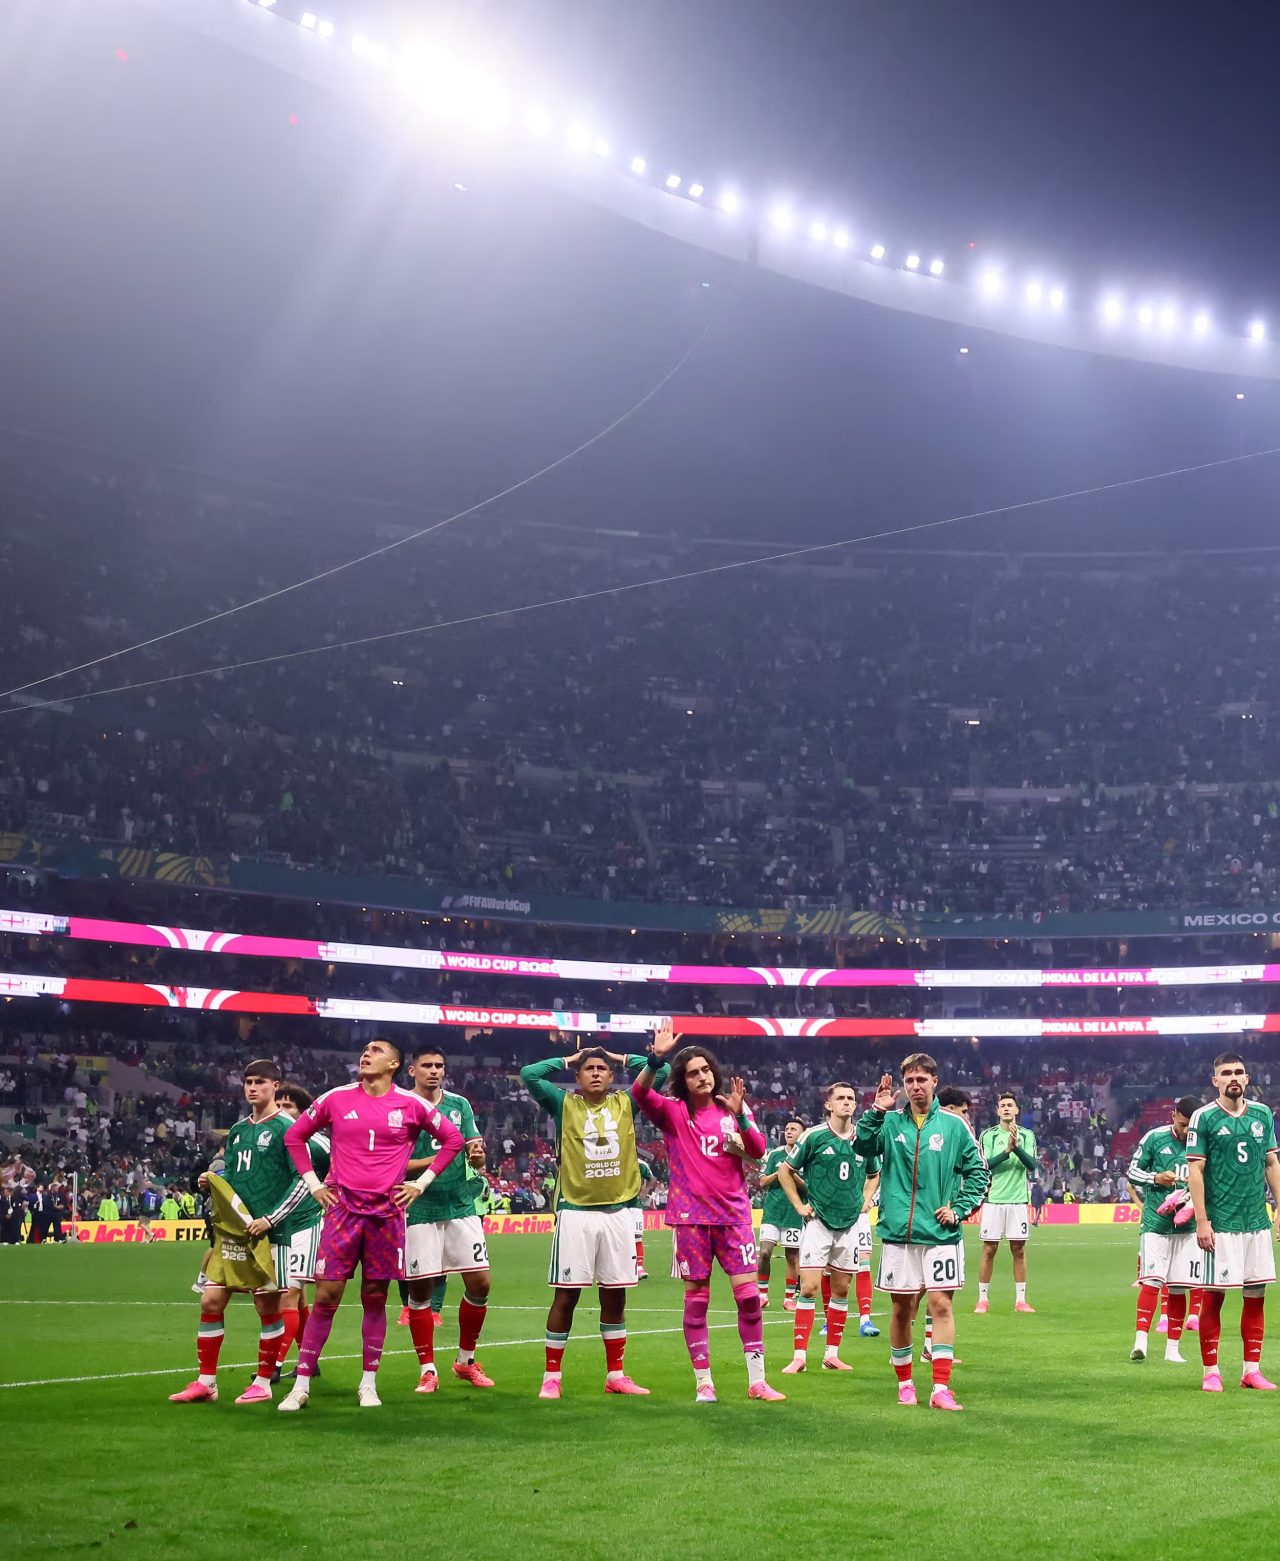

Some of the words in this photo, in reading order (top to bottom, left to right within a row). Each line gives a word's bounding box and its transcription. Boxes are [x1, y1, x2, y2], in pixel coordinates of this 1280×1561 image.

[1184, 914, 1267, 927] MEXICO
[446, 956, 490, 971] WORLD
[491, 959, 516, 974] CUP
[518, 960, 560, 976] 2026
[1027, 973, 1081, 985] MUNDIAL
[1083, 973, 1099, 984] DE
[1100, 973, 1117, 984] LA
[1118, 972, 1144, 983] FIFA
[445, 1011, 489, 1026] WORLD
[490, 1013, 515, 1028] CUP
[1083, 1022, 1099, 1034] DE
[1101, 1022, 1117, 1034] LA
[1118, 1021, 1145, 1033] FIFA
[368, 1129, 375, 1152] 1
[699, 1136, 718, 1157] 12
[236, 1150, 251, 1172] 14
[1237, 1141, 1248, 1164] 5
[585, 1168, 620, 1178] 2026
[839, 1162, 849, 1181] 8
[1174, 1163, 1189, 1182] 10
[1113, 1206, 1140, 1223] Be
[502, 1216, 552, 1234] Active
[1021, 1222, 1028, 1235] 3
[786, 1230, 799, 1243] 25
[290, 1254, 305, 1273] 21
[397, 1248, 403, 1270] 1
[739, 1243, 756, 1266] 12
[933, 1259, 955, 1282] 20
